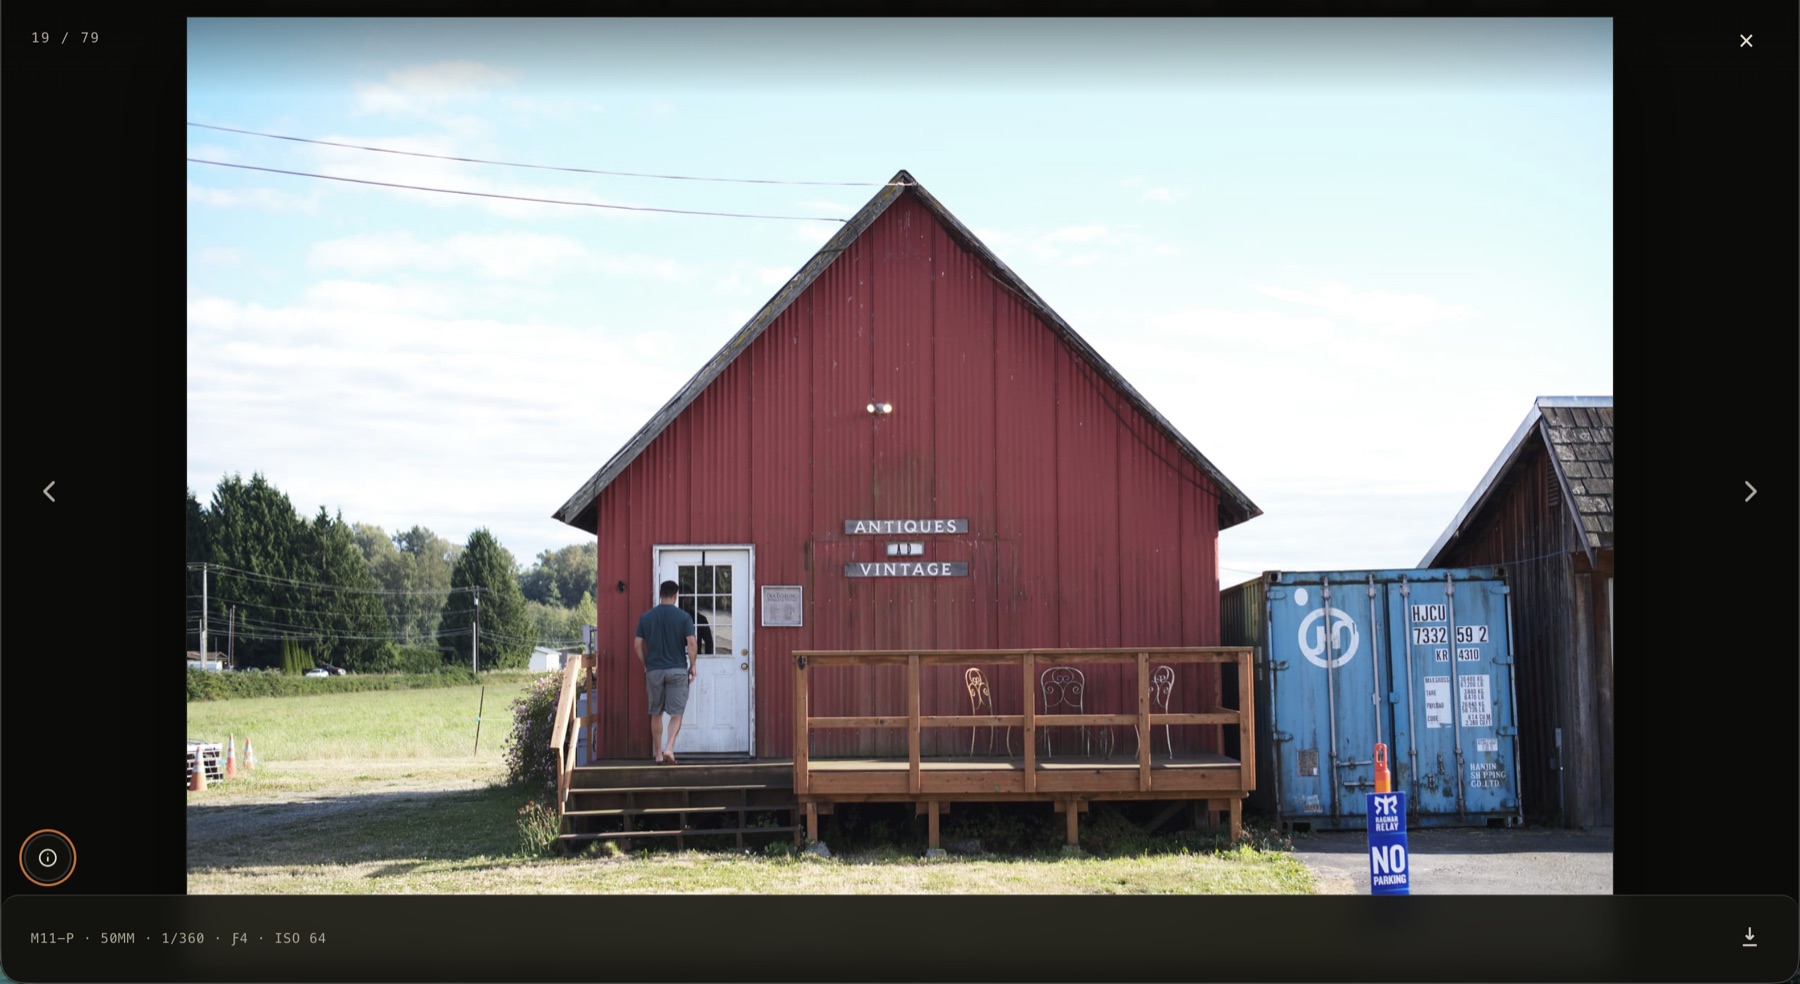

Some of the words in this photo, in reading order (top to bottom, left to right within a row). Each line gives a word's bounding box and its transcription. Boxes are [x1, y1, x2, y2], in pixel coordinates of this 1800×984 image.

[853, 519, 957, 533] ANTIQUES
[860, 562, 952, 576] VINTAGE
[1412, 605, 1446, 621] HJCU
[1413, 627, 1447, 644] 7332
[1456, 626, 1473, 643] 59
[1479, 626, 1487, 643] 2
[1436, 649, 1448, 660] KR
[1458, 649, 1479, 660] 4310
[1470, 763, 1497, 771] HANJIN
[1470, 771, 1506, 779] SHPPING
[1375, 822, 1399, 832] RELAY
[1371, 844, 1406, 875] NO
[1373, 874, 1407, 886] PARKING
